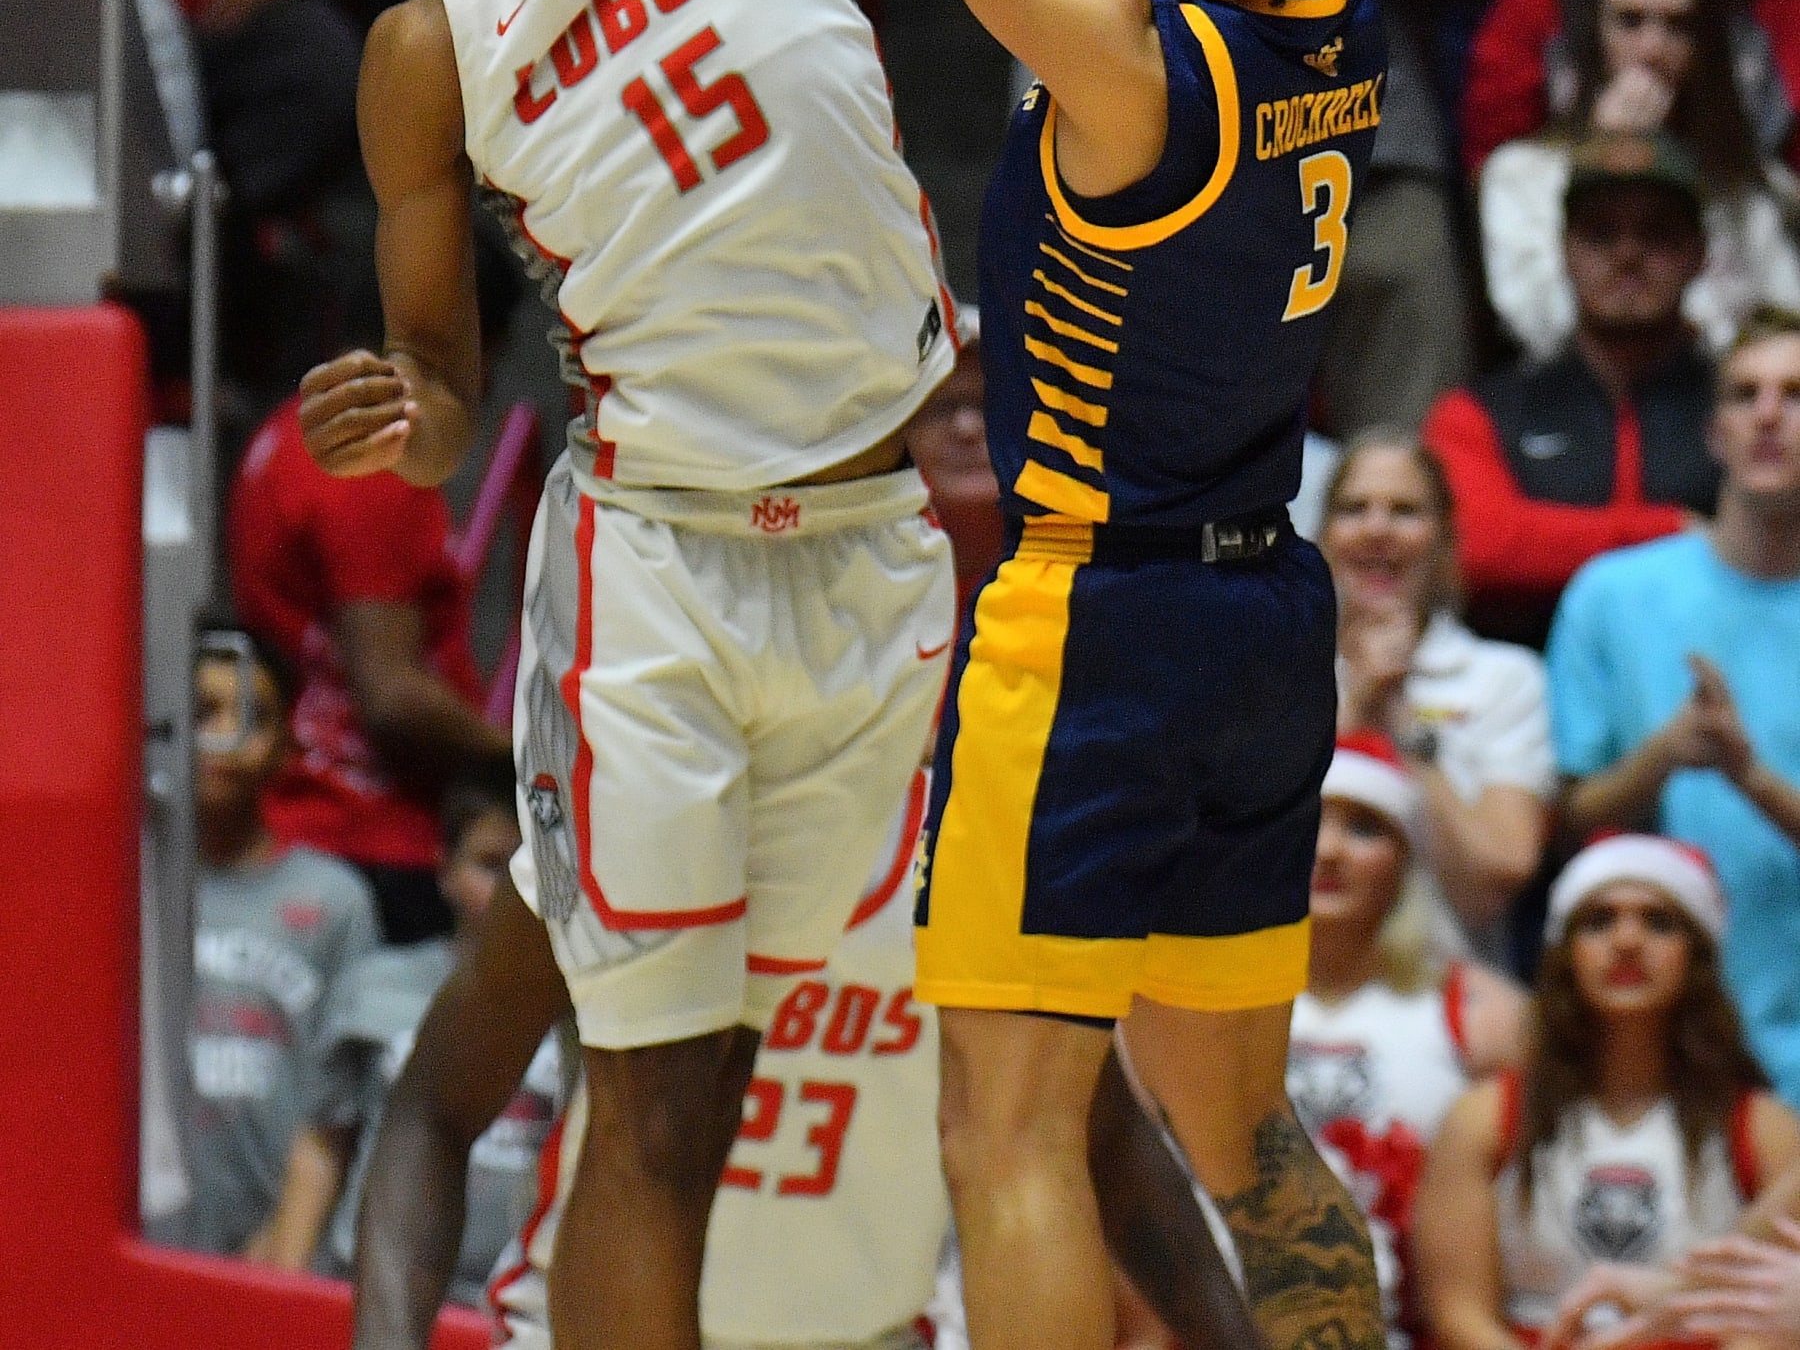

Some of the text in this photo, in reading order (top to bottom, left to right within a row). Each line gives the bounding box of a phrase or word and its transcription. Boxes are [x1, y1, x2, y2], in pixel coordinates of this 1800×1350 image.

[621, 25, 771, 193] 15
[1281, 150, 1352, 321] 3
[767, 981, 923, 1055] BOS
